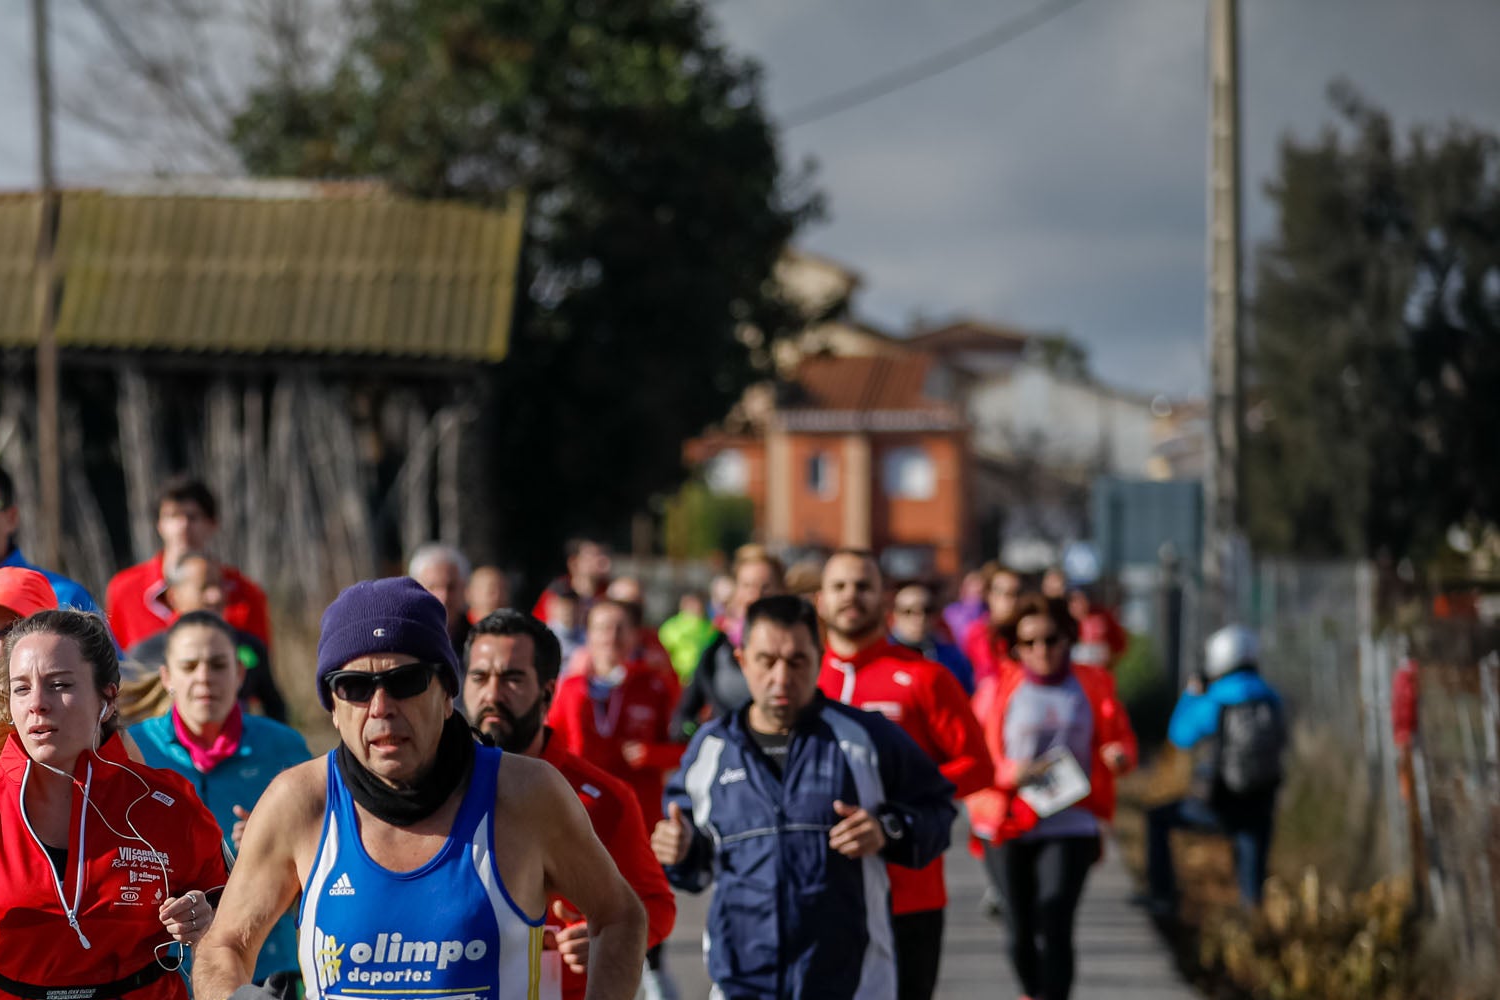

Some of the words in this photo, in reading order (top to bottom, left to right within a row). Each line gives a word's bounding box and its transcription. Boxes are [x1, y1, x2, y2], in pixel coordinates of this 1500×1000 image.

[119, 846, 131, 860] VII
[350, 932, 487, 970] olimpo
[348, 967, 432, 986] deportes
